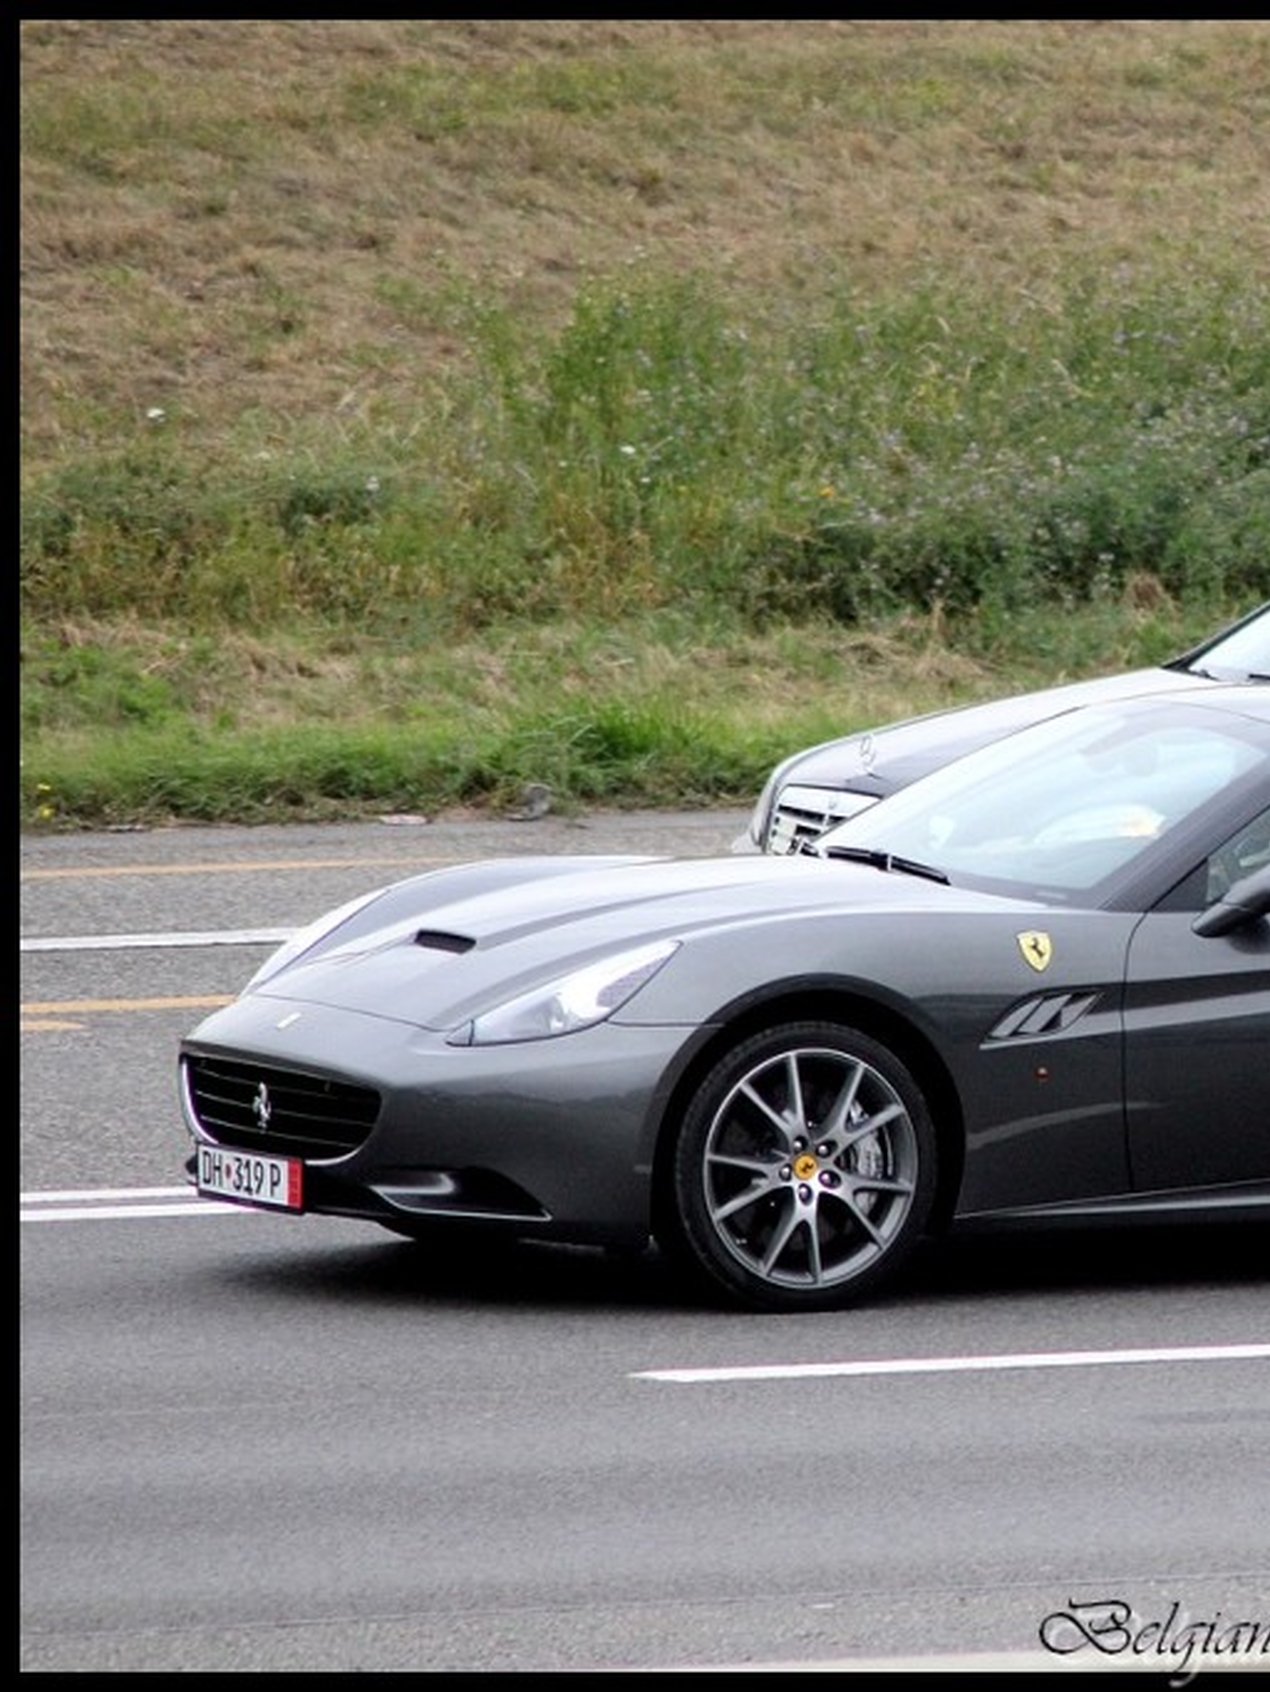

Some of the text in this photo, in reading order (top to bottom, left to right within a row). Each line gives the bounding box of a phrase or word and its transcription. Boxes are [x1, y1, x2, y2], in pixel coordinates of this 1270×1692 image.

[202, 1151, 223, 1187] DH
[233, 1157, 264, 1195] 319
[270, 1164, 281, 1196] P
